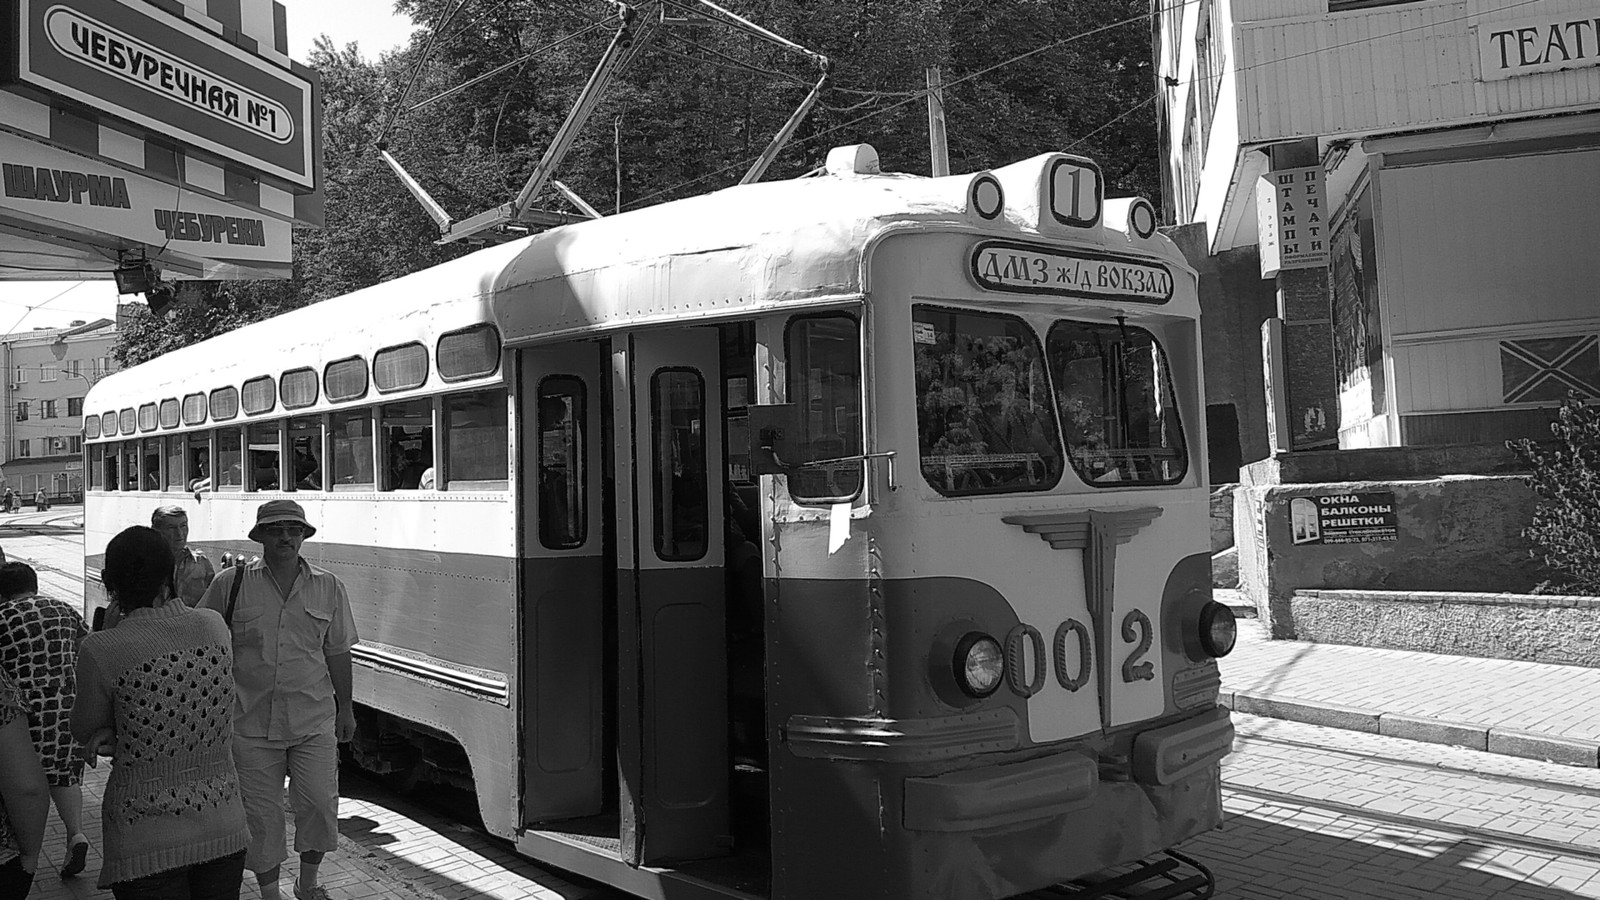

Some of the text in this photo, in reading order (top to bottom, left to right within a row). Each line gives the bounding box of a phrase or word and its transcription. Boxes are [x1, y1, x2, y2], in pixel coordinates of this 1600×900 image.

[71, 22, 278, 133] ЧЕБУРЕЧНАЯ №1
[2, 163, 132, 210] ШАУРМА
[1068, 168, 1082, 220] 1
[154, 209, 266, 248] ЧЕБУРЕКИ
[1277, 173, 1300, 255] ШТАМПЫ
[1304, 170, 1323, 252] ПЕЧАТИ
[983, 252, 1170, 295] ДМЗ ж/д ВОКЗАЛ
[1319, 495, 1360, 505] ОКНА
[1320, 504, 1391, 516] БАЛКОНЫ
[1321, 516, 1385, 527] РЕШЕТКИ
[1004, 608, 1156, 698] 002
